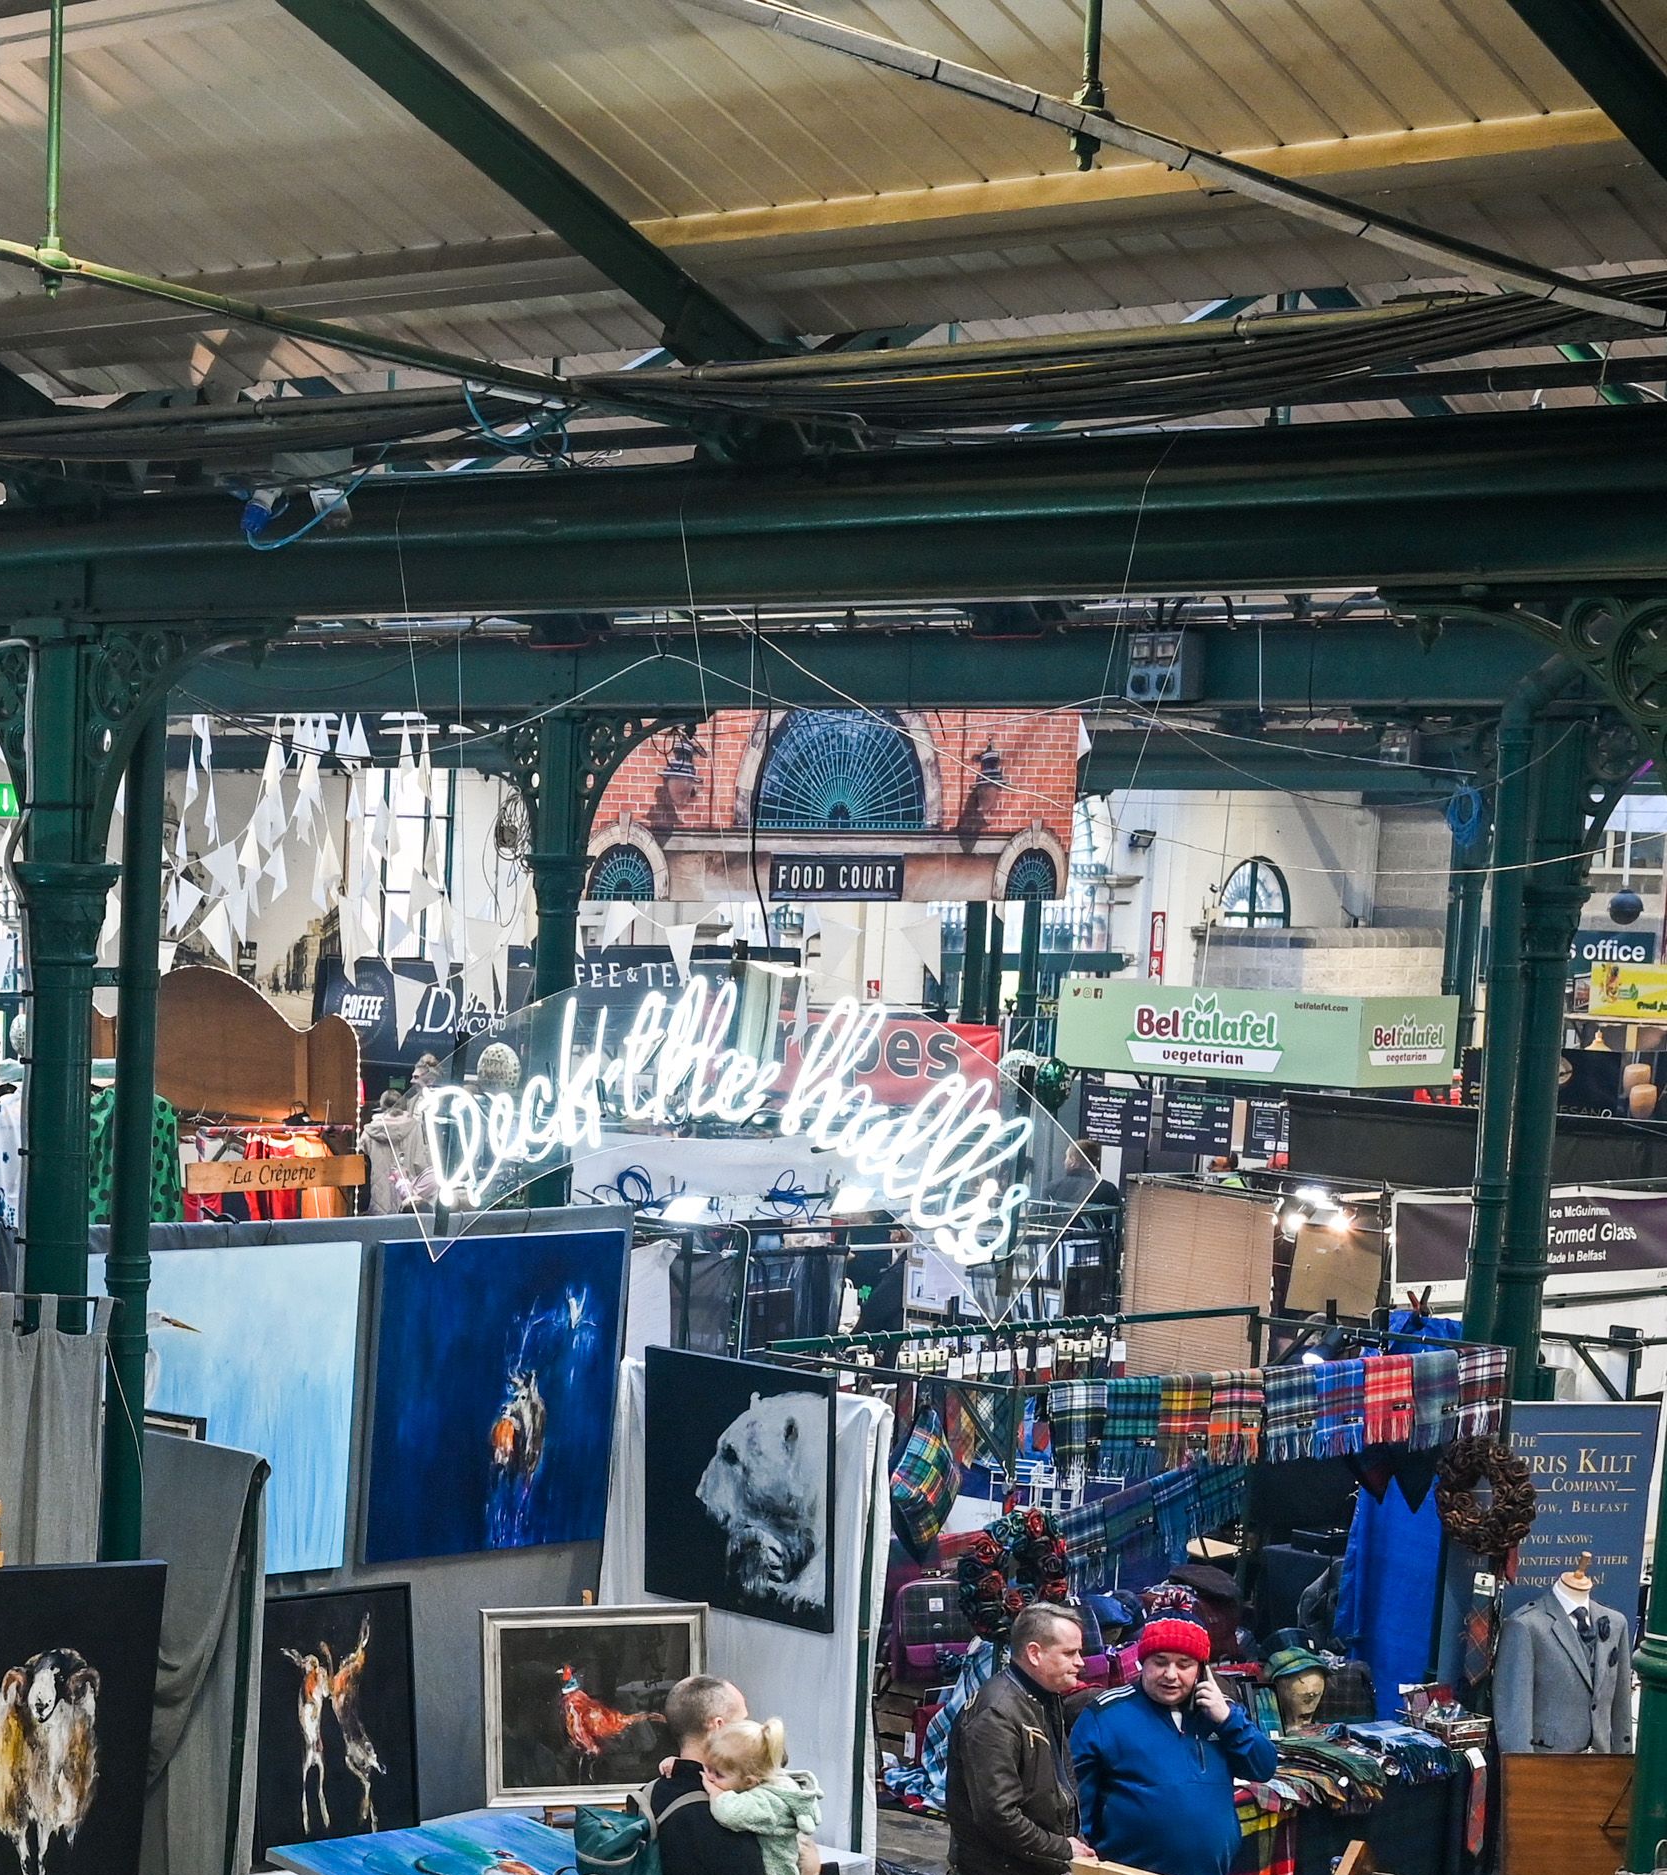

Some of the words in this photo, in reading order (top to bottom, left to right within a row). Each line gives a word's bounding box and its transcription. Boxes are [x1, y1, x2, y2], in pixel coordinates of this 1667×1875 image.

[778, 865, 825, 889] FOOD
[839, 865, 896, 889] COURT
[1583, 940, 1646, 962] office
[626, 967, 639, 983] &
[340, 993, 385, 1021] COFFEE
[1294, 1001, 1349, 1012] belfalafel.com
[1136, 1007, 1276, 1044] Belfalafel
[1373, 1026, 1444, 1047] Belfalafel
[773, 1018, 961, 1086] repes
[1161, 1048, 1244, 1066] vegetarian
[1386, 1052, 1427, 1064] vegetarian
[233, 1166, 253, 1185] La
[1548, 1223, 1597, 1244] Formed
[1600, 1222, 1637, 1241] Glass
[1576, 1248, 1606, 1261] Belfast
[1578, 1448, 1637, 1473] KILT
[1551, 1477, 1618, 1492] COMPANY
[1571, 1500, 1629, 1513] BELFAST
[1531, 1534, 1552, 1544] YOU
[1596, 1556, 1628, 1565] THEIR
